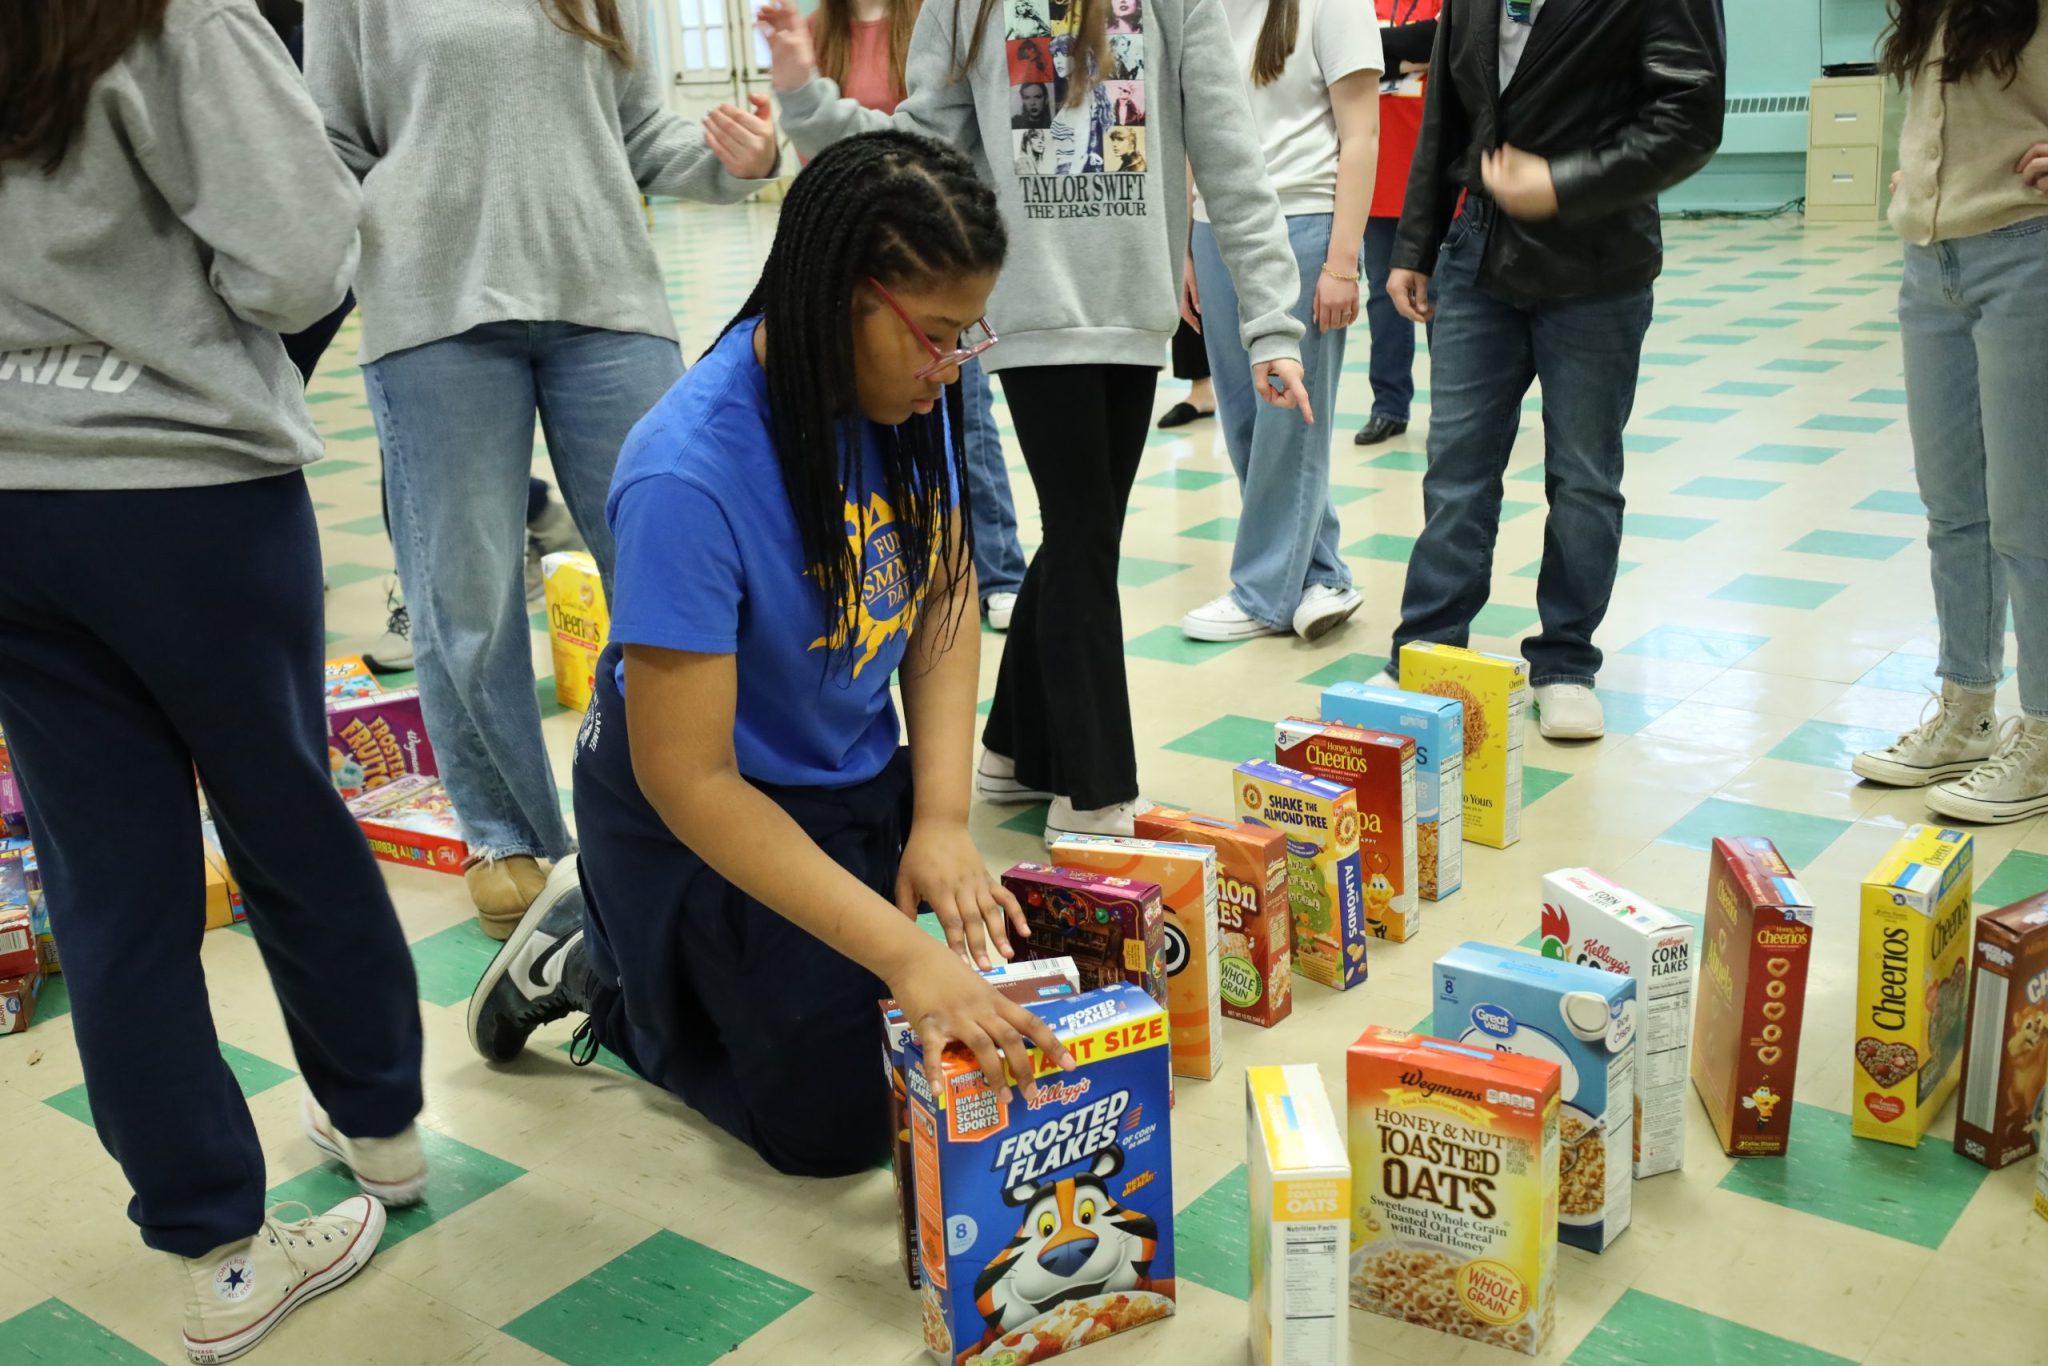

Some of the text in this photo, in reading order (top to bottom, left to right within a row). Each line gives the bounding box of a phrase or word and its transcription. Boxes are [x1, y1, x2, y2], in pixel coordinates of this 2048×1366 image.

[1019, 174, 1146, 203] TAYLOR SWIFT
[1024, 202, 1147, 218] THE ERAS TOUR
[552, 603, 600, 643] Cheerios
[403, 730, 421, 773] Wegman
[1306, 744, 1367, 773] Cheerios
[1327, 741, 1350, 753] Honey
[1350, 745, 1362, 756] Nut
[1269, 795, 1303, 812] SHAKE
[1305, 802, 1318, 812] THE
[1470, 793, 1493, 808] Yours
[1264, 808, 1328, 829] ALMOND TREE
[1345, 865, 1357, 938] ALMONDS
[1594, 891, 1621, 906] CORN
[1757, 930, 1808, 945] Cheerios
[1584, 938, 1631, 975] Kellogg's
[1652, 943, 1688, 964] CORN
[1221, 962, 1255, 991] WHOLE
[1652, 958, 1688, 977] FLAKES
[1871, 927, 1909, 1031] Cheerios
[1221, 978, 1249, 1000] GRAIN
[1445, 980, 1454, 994] 8
[1059, 999, 1116, 1026] FROSTED
[1069, 1007, 1117, 1031] FLAKES
[1476, 1009, 1509, 1027] Great
[1104, 1018, 1163, 1052] SIZE
[1484, 1019, 1509, 1034] Value
[908, 1068, 930, 1092] FROST
[951, 1070, 983, 1085] MISSION
[1398, 1070, 1481, 1101] Wegmans
[956, 1095, 972, 1106] BUY
[982, 1090, 995, 1099] BO
[956, 1097, 998, 1114] SUPPORT
[1027, 1077, 1091, 1111] Kellogg's
[957, 1106, 999, 1123] SCHOOL
[957, 1115, 1000, 1134] SPORTS
[995, 1090, 1129, 1169] FROSTED
[1122, 1122, 1157, 1146] OF CORN
[1375, 1107, 1505, 1150] HONEY & NUT
[1005, 1118, 1119, 1189] FLAKES
[1377, 1125, 1500, 1177] TOASTED
[1383, 1158, 1497, 1220] OATS
[1286, 1199, 1338, 1213] OATS
[1370, 1195, 1508, 1238] Sweetened Whole Grain
[955, 1222, 968, 1239] 8
[1384, 1208, 1492, 1245] Toasted Oat Cereal
[1391, 1221, 1485, 1255] with Real Honey
[216, 1255, 247, 1284] CONVERSE
[1469, 1267, 1519, 1306] WHOLE
[1467, 1287, 1508, 1317] GRAIN
